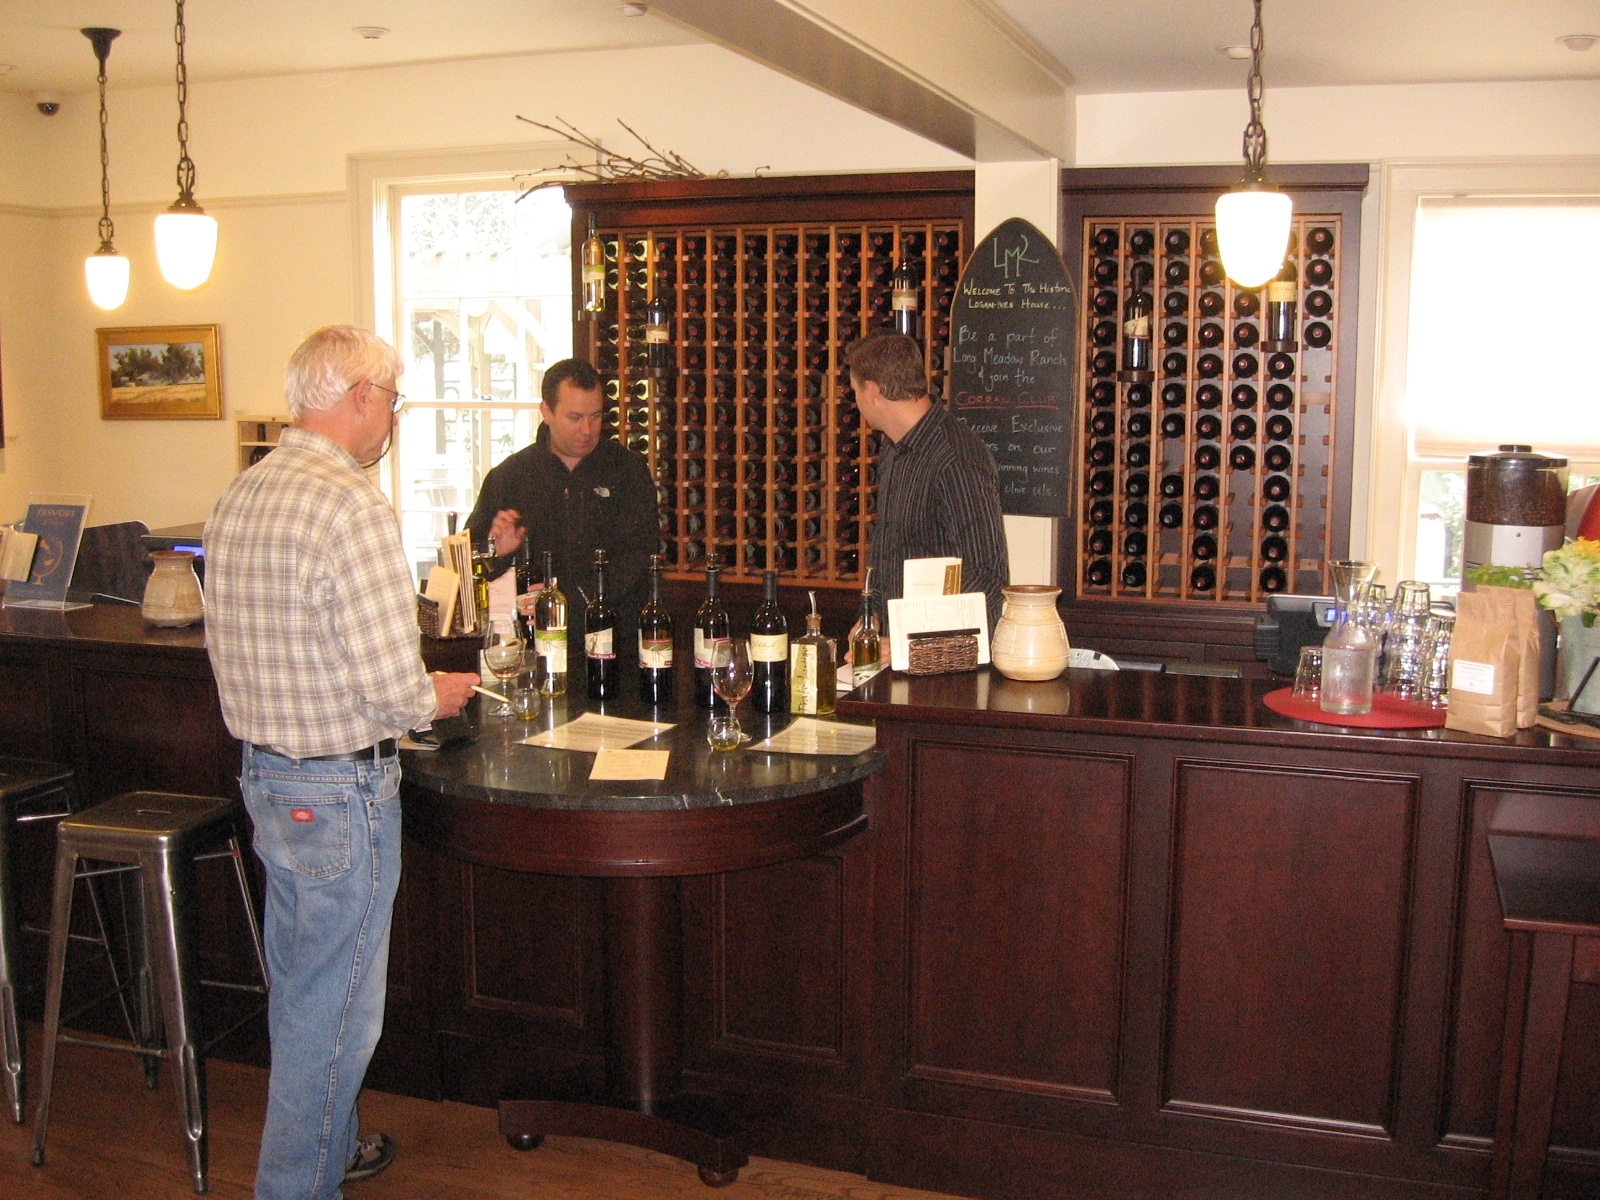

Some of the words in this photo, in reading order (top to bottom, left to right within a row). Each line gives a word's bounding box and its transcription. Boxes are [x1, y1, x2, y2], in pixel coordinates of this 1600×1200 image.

[958, 325, 978, 345] Be
[988, 332, 996, 342] a
[1006, 328, 1035, 349] part
[1044, 327, 1058, 346] of
[953, 347, 976, 374] Long
[983, 347, 1023, 365] Meadow
[1030, 349, 1067, 366] Ranch
[984, 371, 1009, 392] join
[1014, 366, 1036, 387] the
[1011, 415, 1064, 433] Exclusive
[1008, 444, 1022, 452] on
[1033, 445, 1057, 454] our
[1033, 465, 1060, 475] wines
